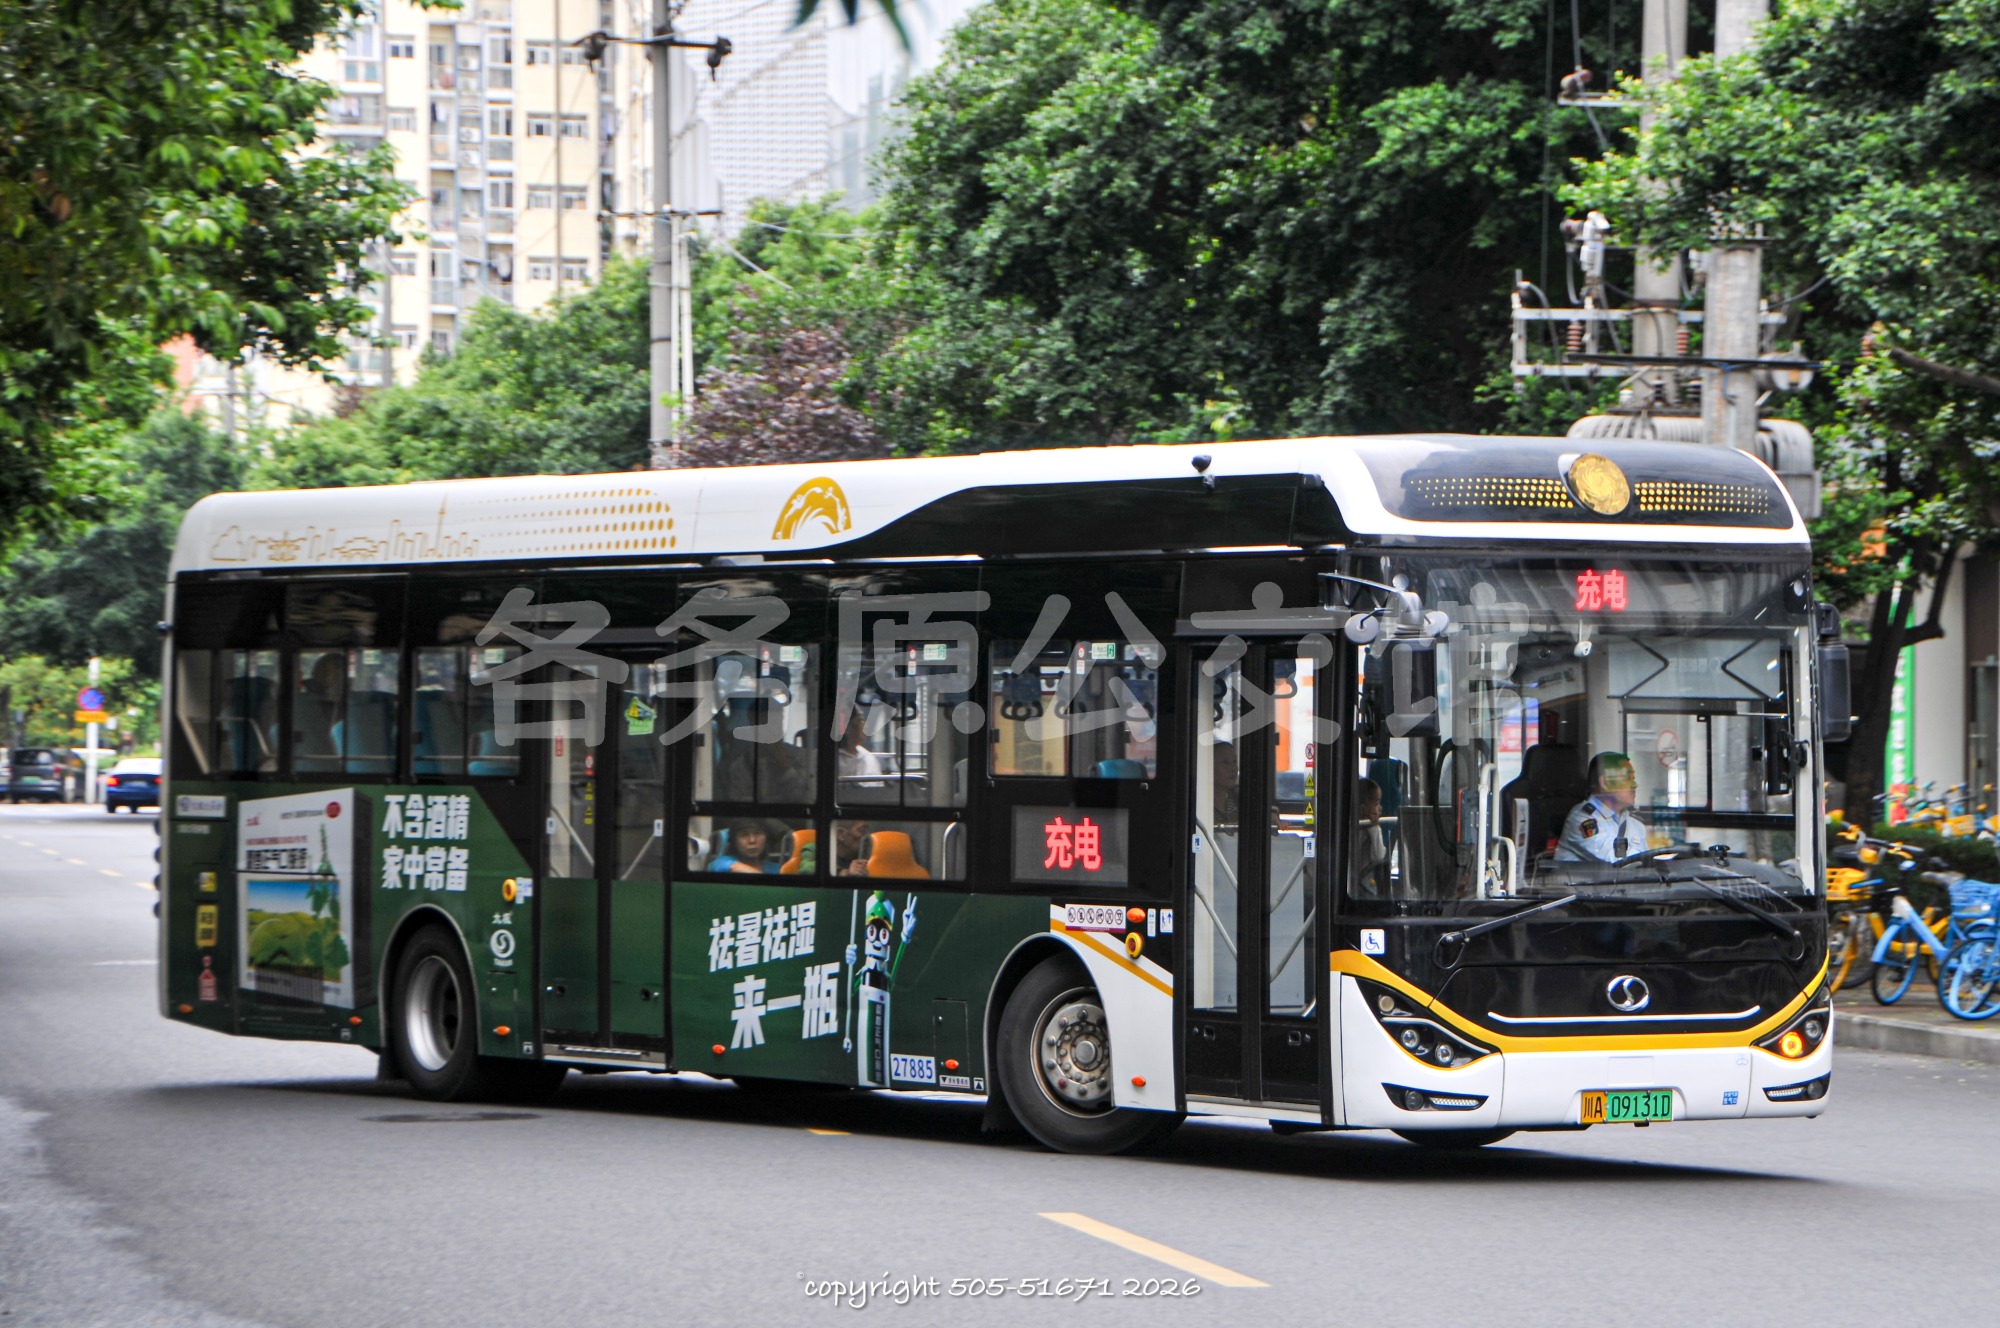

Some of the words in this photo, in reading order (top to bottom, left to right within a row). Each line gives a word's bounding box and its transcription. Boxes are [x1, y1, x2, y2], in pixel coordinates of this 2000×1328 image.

[1575, 569, 1628, 611] 充电
[382, 794, 470, 840] 不含酒精
[1044, 816, 1102, 871] 充电
[381, 845, 469, 891] 家中常备
[708, 900, 817, 973] 祛暑祛湿
[730, 961, 840, 1049] 来一瓶
[893, 1057, 933, 1080] 27885
